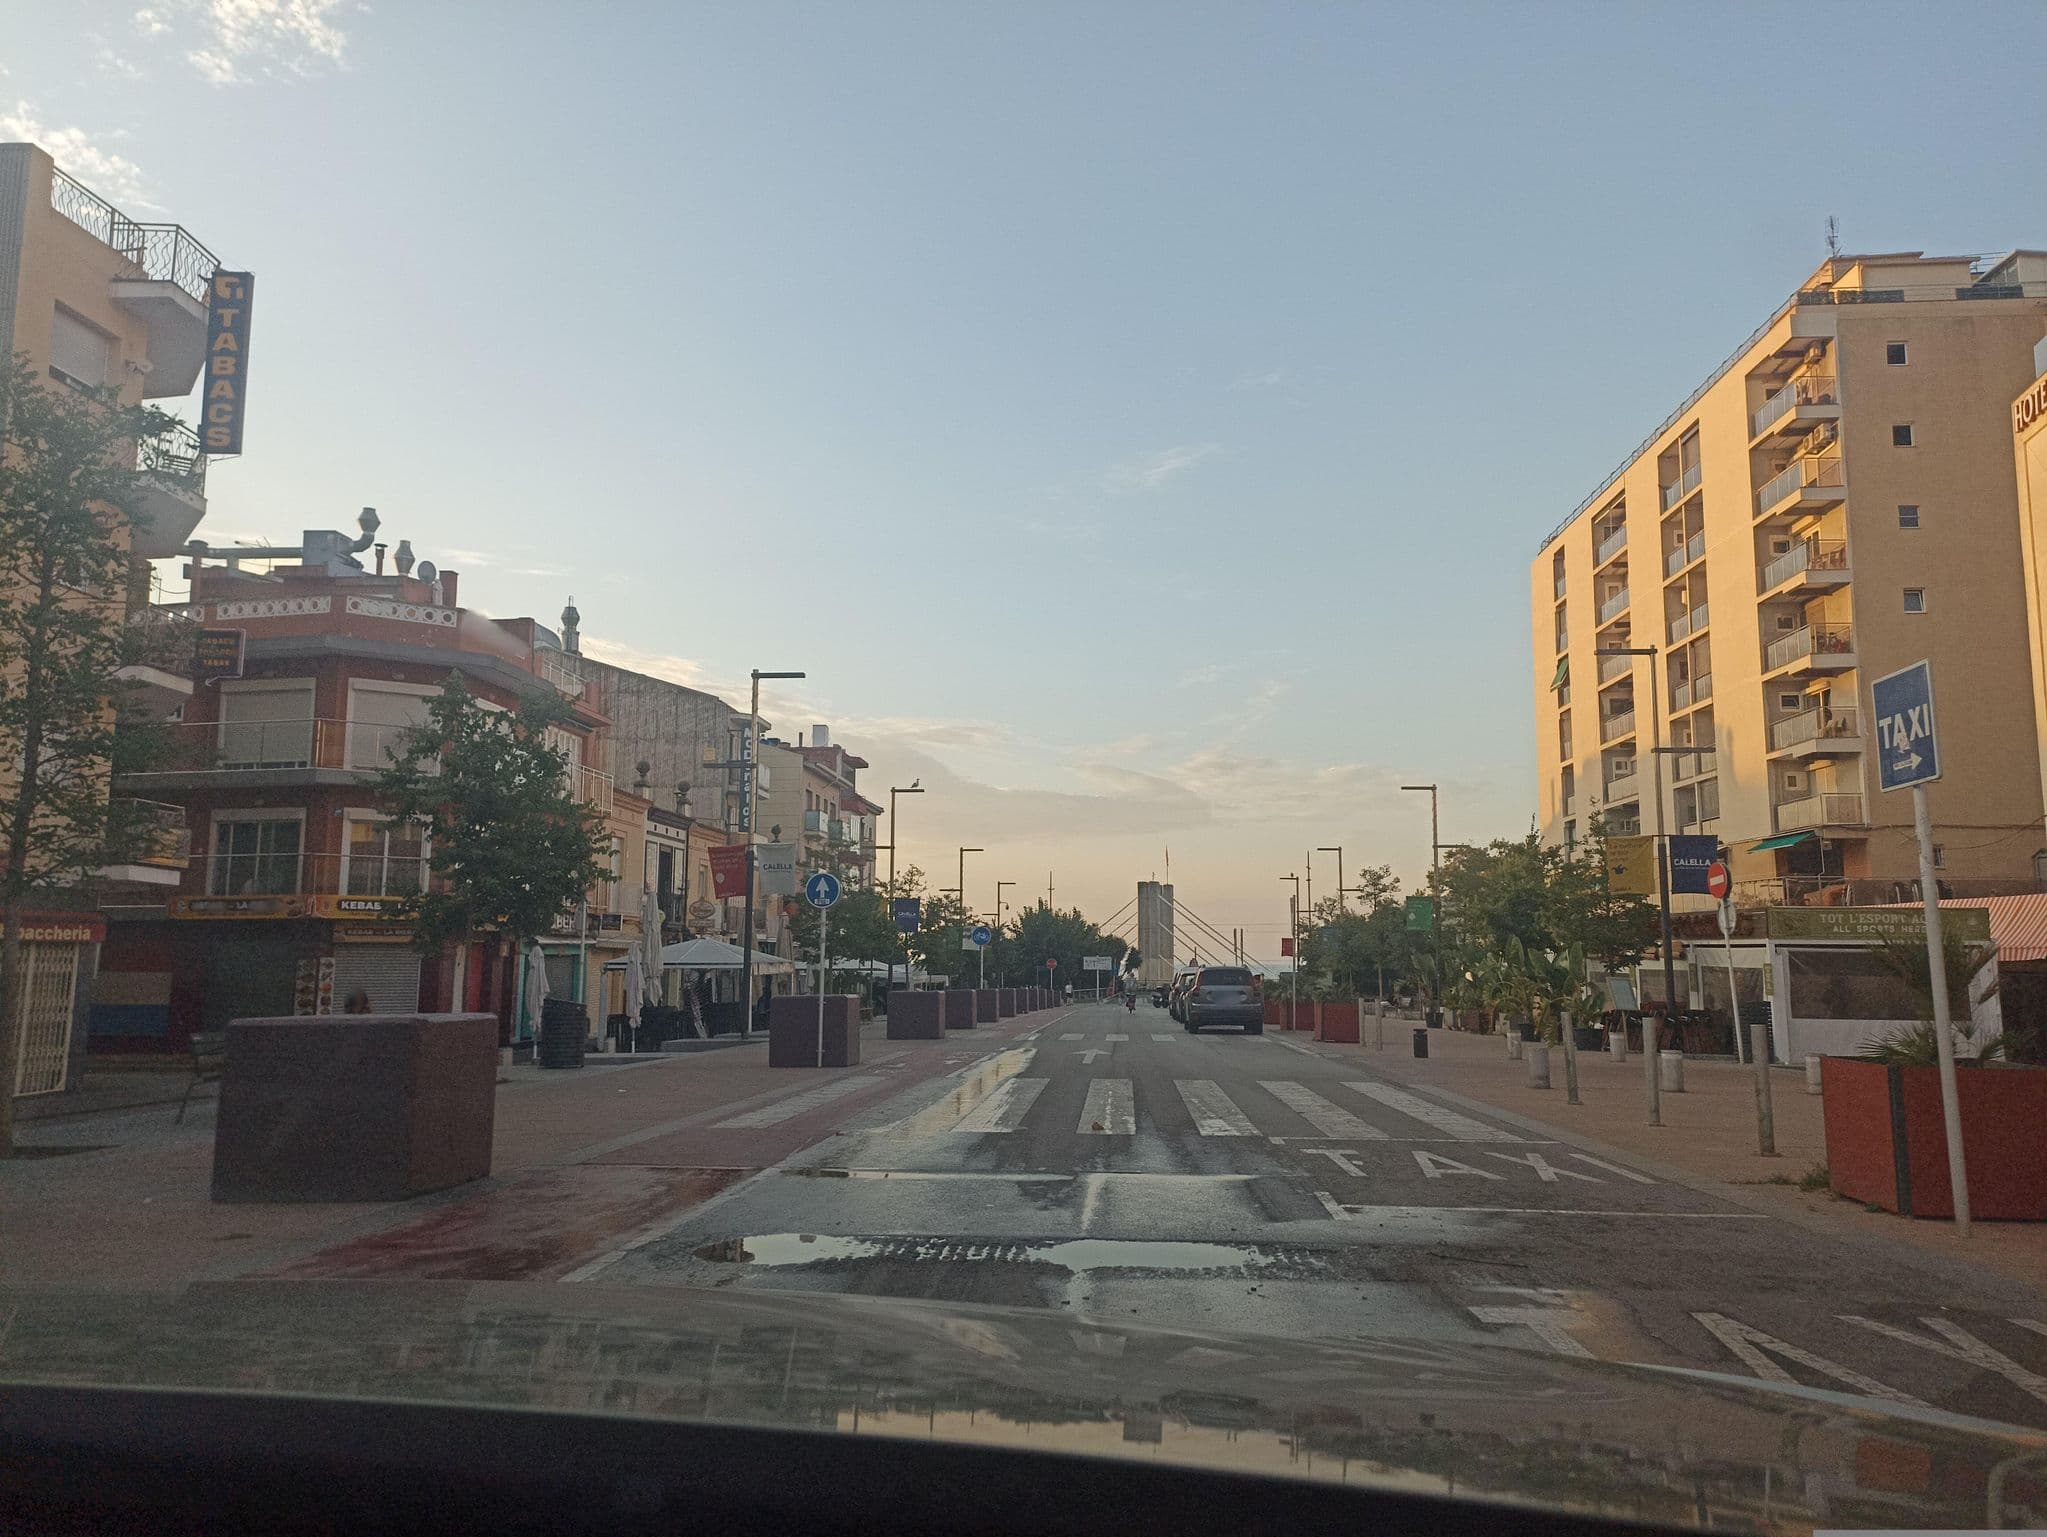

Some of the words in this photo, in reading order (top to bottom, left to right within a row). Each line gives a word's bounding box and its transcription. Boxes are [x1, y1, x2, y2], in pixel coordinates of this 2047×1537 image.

[206, 308, 240, 448] TABACS
[1878, 703, 1931, 750] TAXI
[762, 863, 793, 871] CALELLA
[1673, 858, 1712, 867] CALELLA
[340, 900, 382, 910] KEBAB
[1819, 913, 1844, 924] TOT
[1849, 913, 1906, 924] L'ESPORT
[1832, 925, 1851, 933] ALL
[1856, 925, 1895, 933] SPORTS
[1299, 1148, 1661, 1185] TAXI
[1467, 1304, 2047, 1410] TAX
